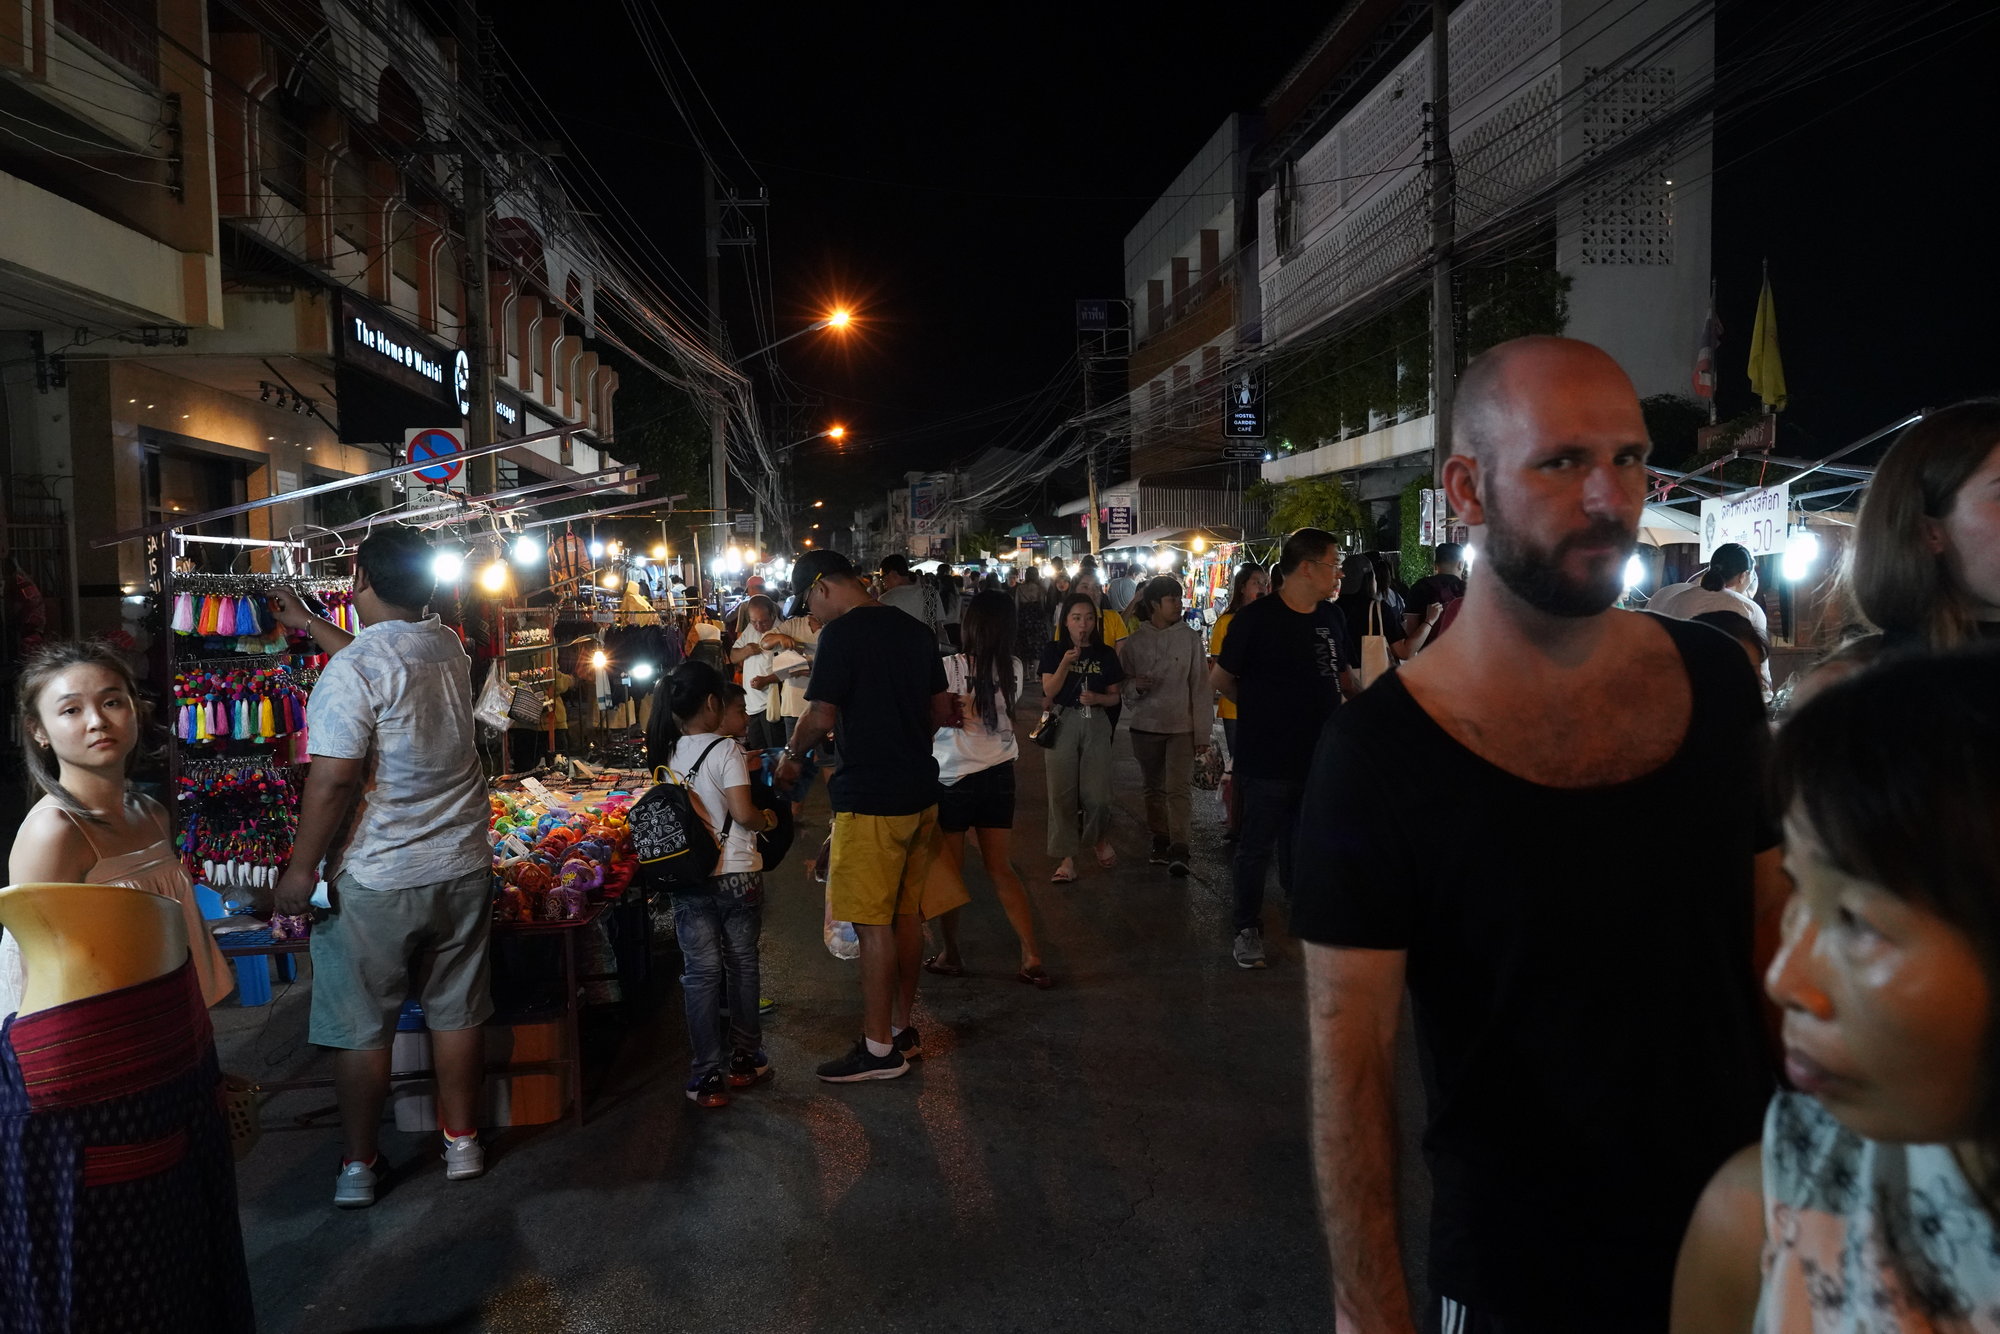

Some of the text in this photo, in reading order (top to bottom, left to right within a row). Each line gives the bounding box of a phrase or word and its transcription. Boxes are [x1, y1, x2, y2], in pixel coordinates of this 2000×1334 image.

[354, 317, 443, 384] The Home @ Wualai
[496, 401, 516, 424] assage
